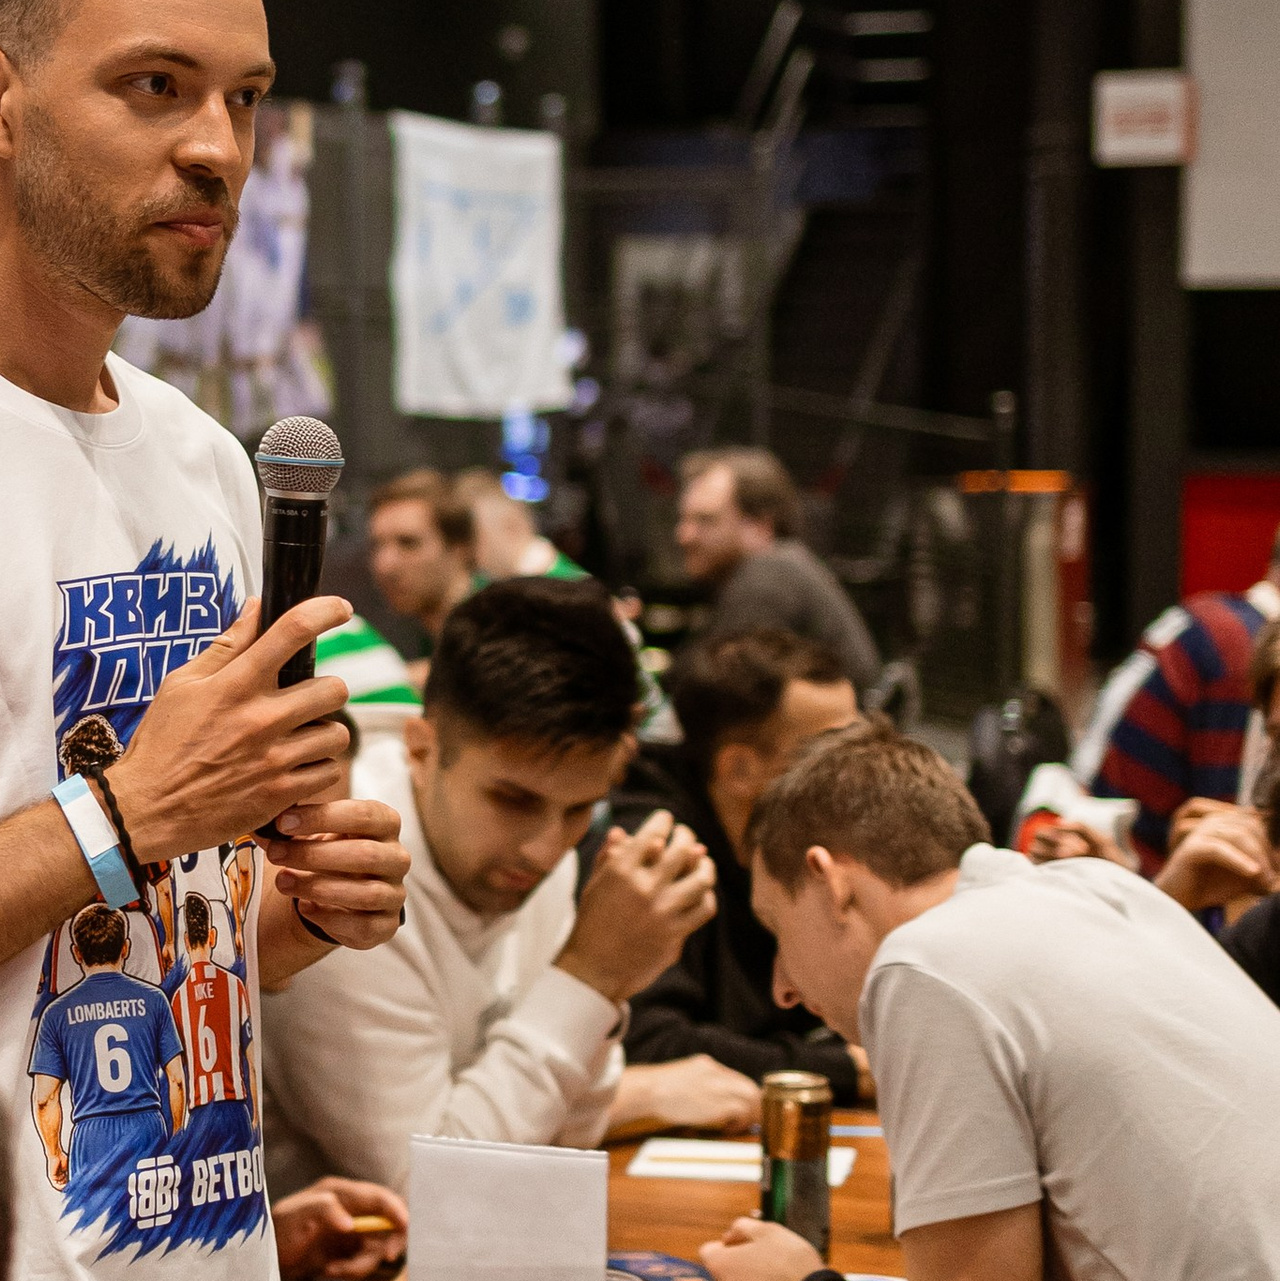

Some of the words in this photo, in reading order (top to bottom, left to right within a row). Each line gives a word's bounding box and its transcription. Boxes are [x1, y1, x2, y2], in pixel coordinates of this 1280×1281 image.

[57, 572, 222, 652] КВИЗ
[66, 998, 147, 1025] LOMBAERTS
[198, 1005, 218, 1073] 6
[94, 1023, 132, 1093] 6
